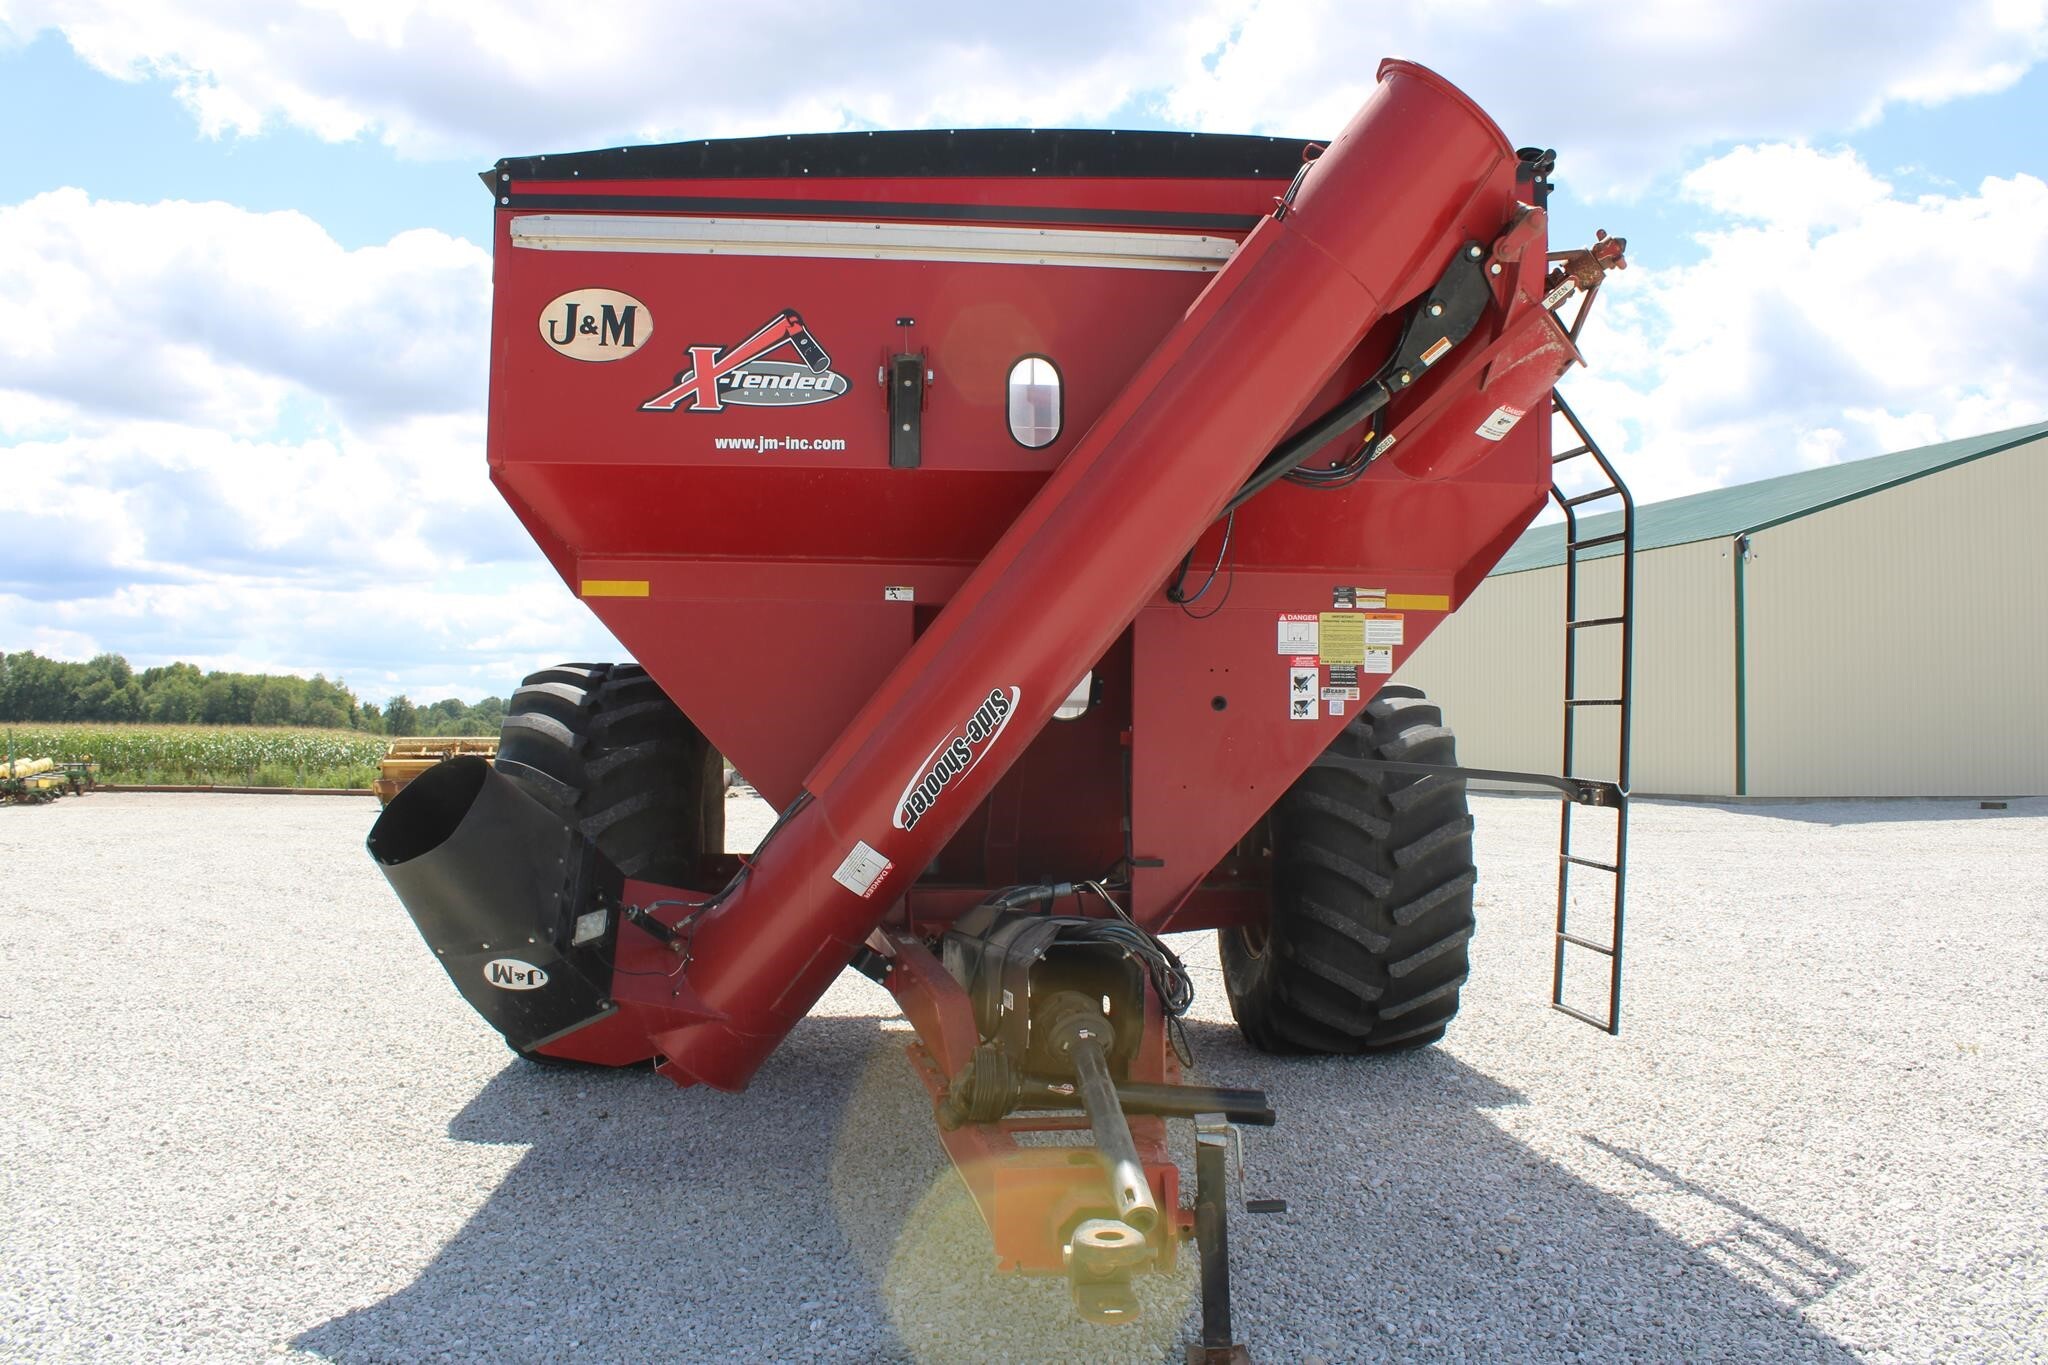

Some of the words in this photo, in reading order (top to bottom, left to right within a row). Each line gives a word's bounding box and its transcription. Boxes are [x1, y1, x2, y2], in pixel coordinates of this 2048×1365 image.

[1549, 285, 1568, 303] OPEN
[548, 303, 637, 347] J&M
[641, 314, 836, 411] X-Tended
[715, 436, 846, 453] www.jm-inc.com
[902, 688, 1010, 831] Side-Shooter
[864, 870, 888, 898] DANGER
[492, 963, 544, 985] J&M
